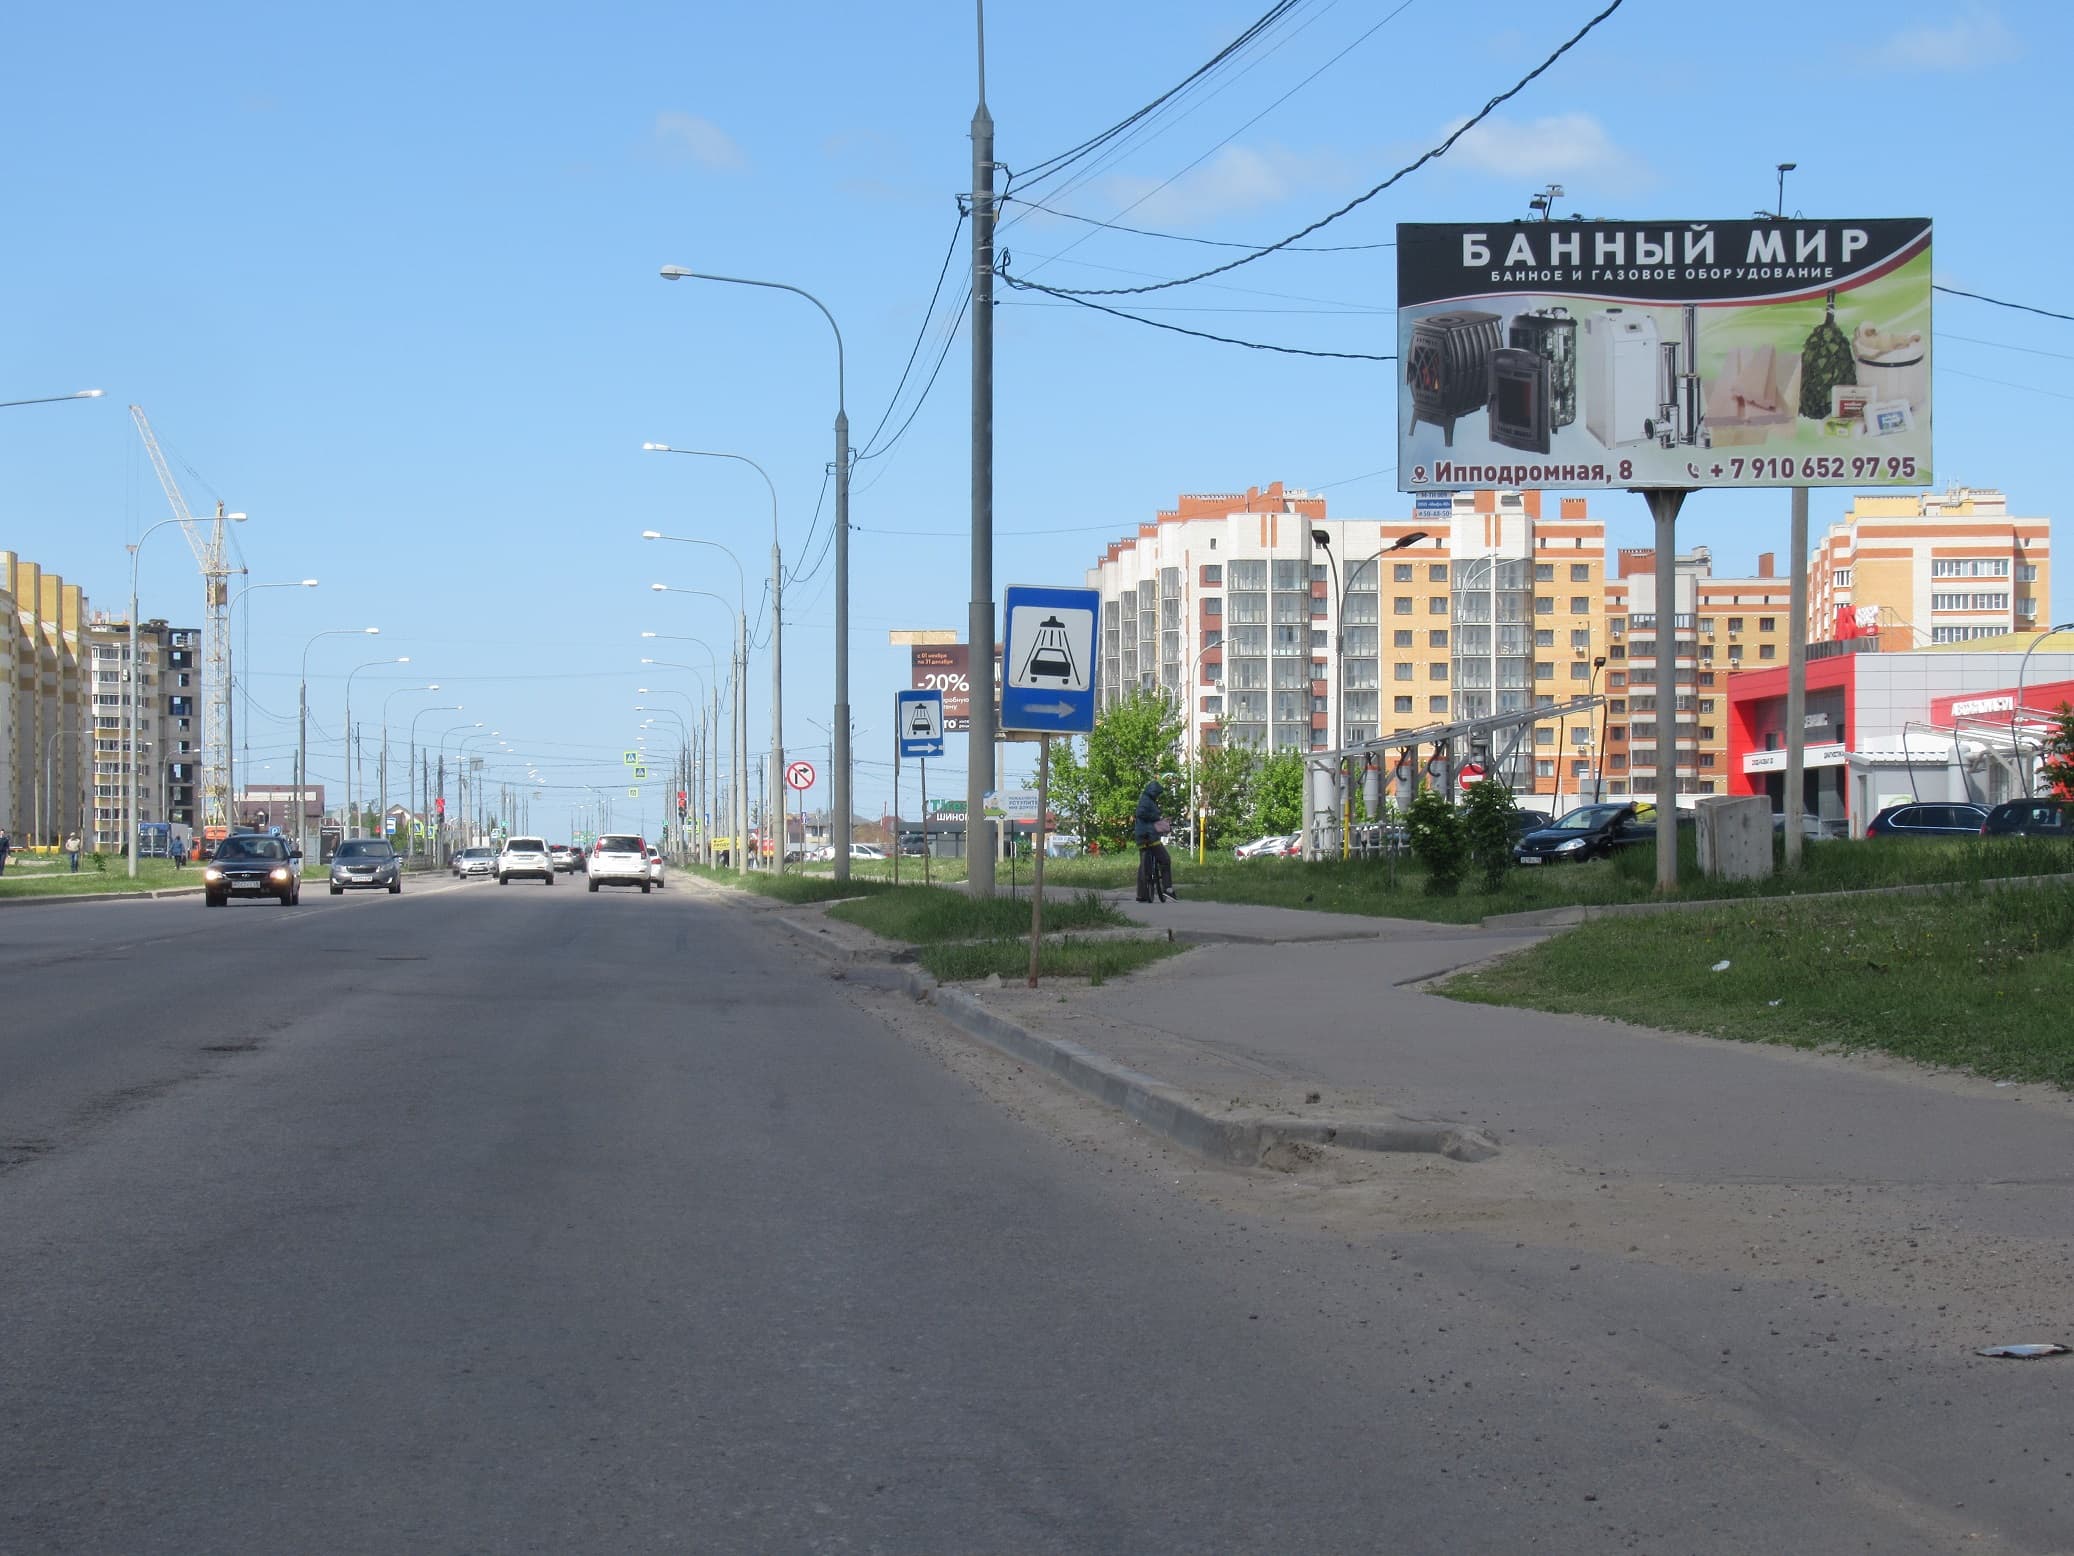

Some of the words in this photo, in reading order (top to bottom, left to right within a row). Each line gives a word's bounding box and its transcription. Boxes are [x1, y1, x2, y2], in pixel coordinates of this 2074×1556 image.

[1462, 224, 1715, 267] БАННЫЙ
[1746, 229, 1869, 264] МИР
[1491, 270, 1563, 282] БАННОЕ
[1572, 270, 1582, 281] И
[1592, 269, 1676, 281] ГАЗОВОЕ
[1685, 266, 1833, 280] ОБОРУДОВАНИЕ
[1434, 461, 1612, 486] Ипподромная,
[1619, 460, 1633, 480] 8
[1751, 458, 1794, 478] 910
[1801, 457, 1844, 478] 652
[1851, 457, 1880, 477] 97
[1887, 456, 1915, 477] 95
[917, 673, 969, 692] -20%
